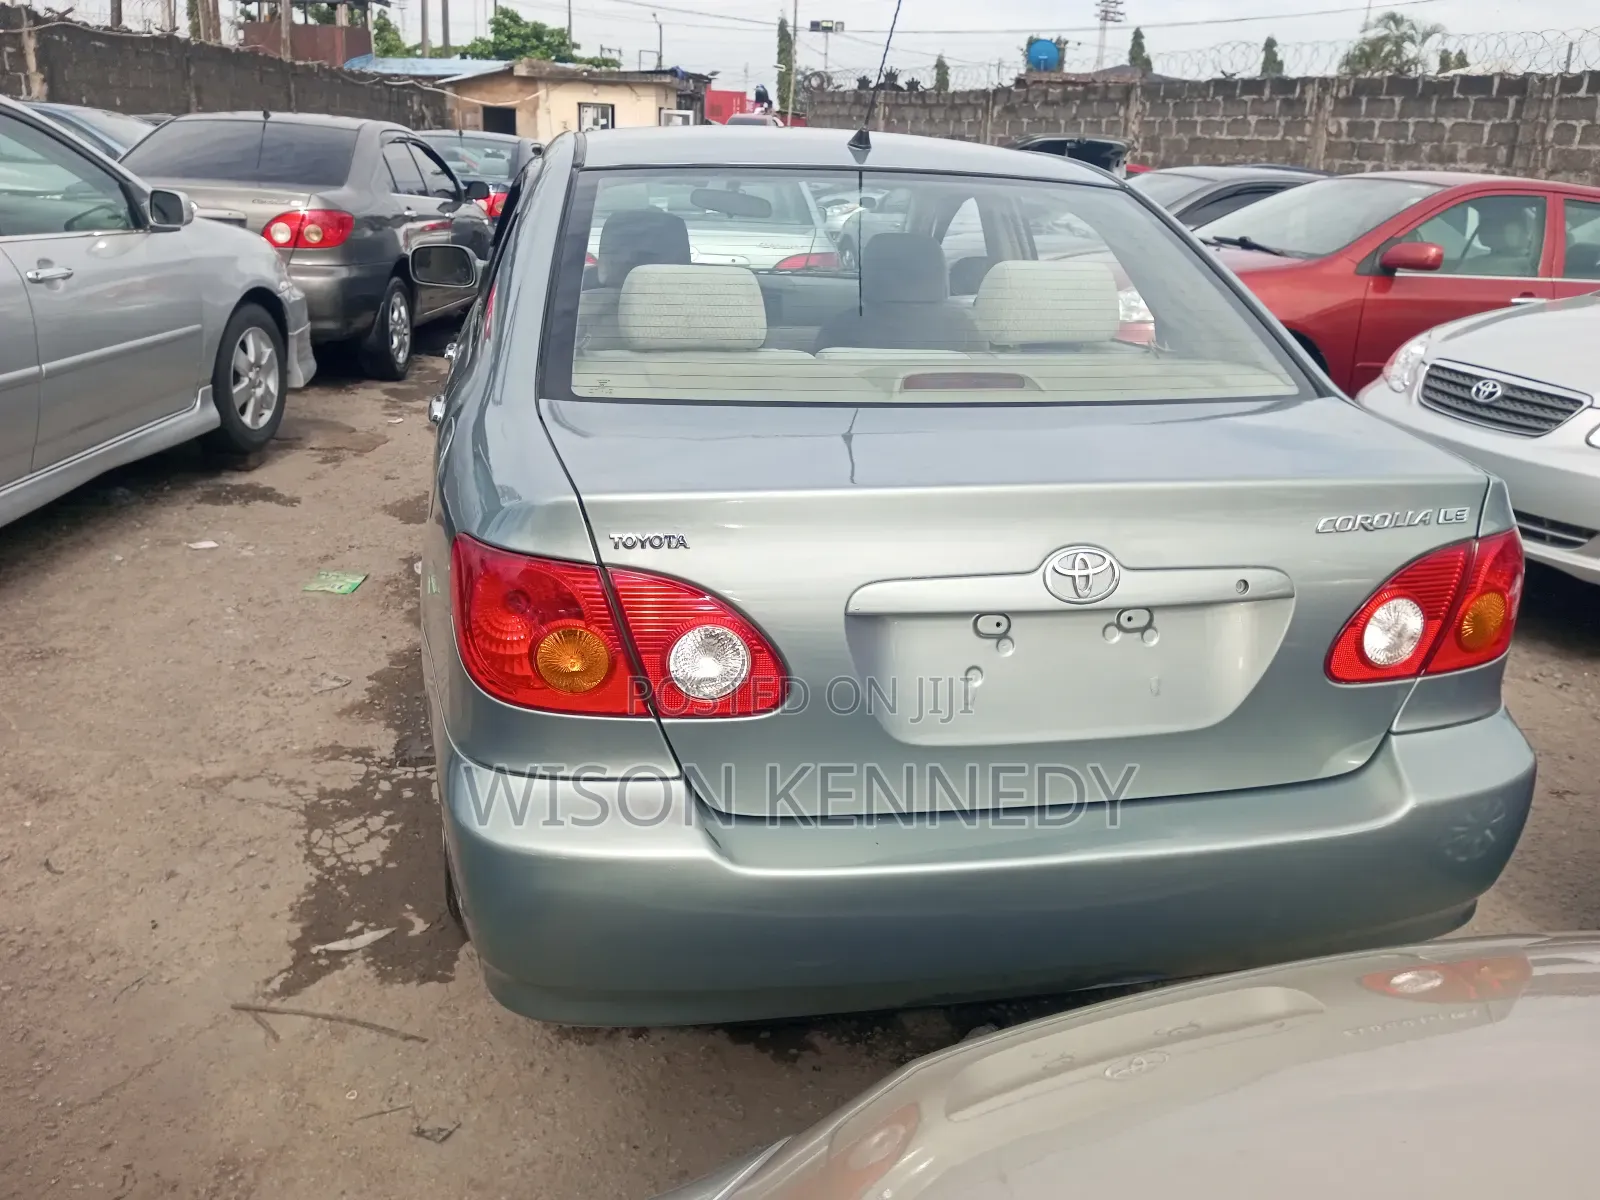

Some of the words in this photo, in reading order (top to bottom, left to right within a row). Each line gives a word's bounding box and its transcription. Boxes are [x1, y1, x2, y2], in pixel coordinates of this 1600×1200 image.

[1316, 509, 1433, 533] COROLLA
[1440, 508, 1469, 523] LE
[609, 532, 690, 549] TOYOTA
